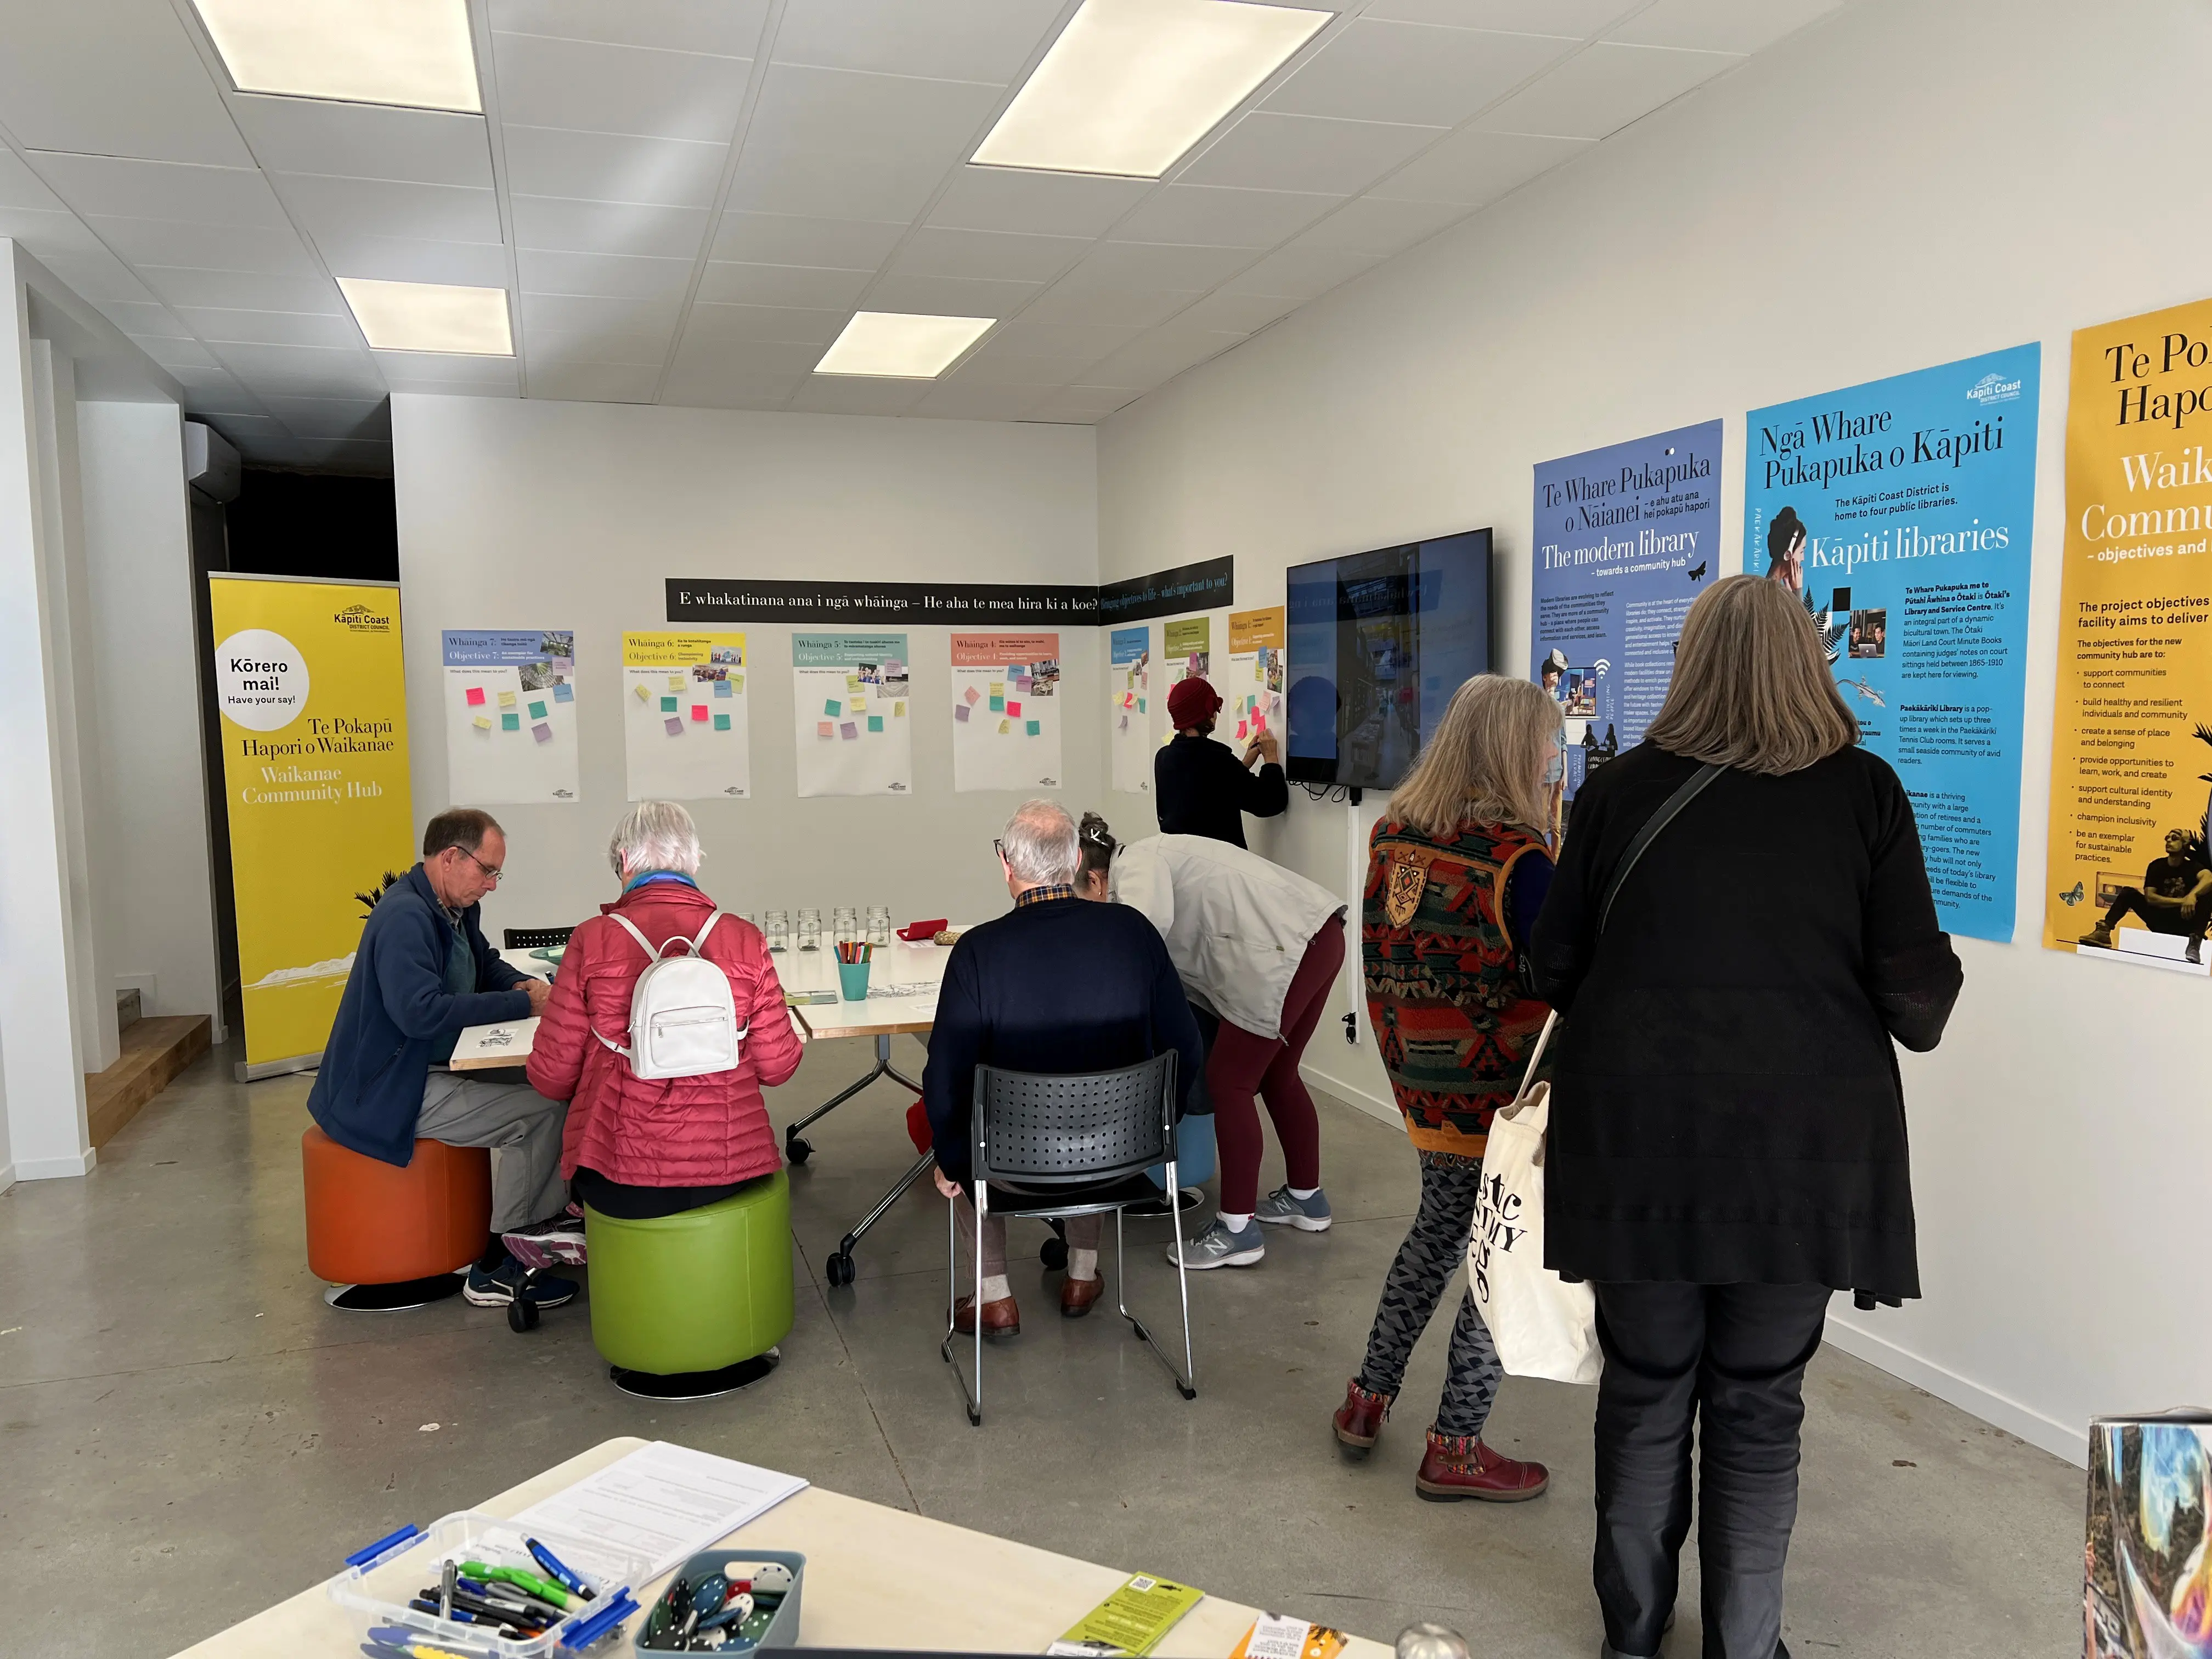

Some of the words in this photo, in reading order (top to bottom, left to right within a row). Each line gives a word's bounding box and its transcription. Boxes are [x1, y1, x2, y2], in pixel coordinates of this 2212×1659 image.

[2105, 343, 2150, 383] Te
[2159, 325, 2212, 373] Po
[1995, 380, 2021, 393] Coast
[1759, 422, 1805, 460] Ngā
[1811, 410, 1892, 445] Whare
[1764, 443, 1883, 490] Pukapuka
[1889, 445, 1905, 467] o
[1911, 416, 2004, 469] Kāpiti
[1543, 484, 1561, 508] Te
[1565, 477, 1616, 504] Whare
[1620, 453, 1711, 493] Pukapuka
[1656, 496, 1669, 506] ahu
[1671, 495, 1683, 504] atu
[1685, 492, 1699, 501] ana
[1835, 498, 1850, 508] The
[1852, 493, 1877, 506] Kāpiti
[1879, 490, 1904, 501] Coast
[1906, 484, 1939, 497] District
[1942, 483, 1949, 493] is
[1565, 517, 1573, 532] o
[1578, 496, 1639, 531] Nāianei
[1644, 509, 1655, 519] hei
[1657, 504, 1684, 518] pokapū
[1685, 498, 1710, 515] hapori
[1835, 509, 1857, 521] home
[1859, 507, 1868, 517] to
[1870, 505, 1887, 516] four
[1889, 501, 1916, 516] public
[1918, 496, 1958, 510] libraries.
[1542, 545, 1571, 569] The
[1575, 537, 1634, 565] modern
[1639, 529, 1700, 558] library
[1810, 530, 1888, 575] Kāpiti
[1895, 518, 2010, 560] libraries
[2098, 541, 2172, 563] objectives
[2177, 539, 2206, 555] and
[1596, 566, 1623, 577] towards
[1630, 559, 1670, 573] community
[1672, 557, 1686, 567] hub
[1148, 588, 1156, 600] life
[1177, 578, 1204, 598] important
[1206, 578, 1212, 589] to
[1214, 572, 1227, 592] you?
[680, 591, 690, 604] E
[696, 592, 784, 606] whakatinana
[789, 597, 812, 607] ana
[817, 594, 822, 607] i
[826, 595, 849, 610] ngā
[854, 595, 907, 611] whāinga
[924, 596, 943, 608] He
[946, 596, 968, 608] aha
[974, 599, 985, 608] te
[989, 601, 1014, 610] mea
[1018, 597, 1042, 610] hira
[1046, 598, 1057, 610] ki
[1062, 601, 1068, 610] a
[1072, 599, 1097, 610] koe?
[2079, 602, 2098, 612] The
[2101, 600, 2143, 613] project
[2146, 596, 2209, 610] objectives
[364, 615, 390, 624] Coast
[2079, 617, 2116, 629] facility
[2119, 615, 2147, 625] aims
[2151, 615, 2163, 624] to
[2167, 612, 2209, 623] deliver
[629, 639, 665, 648] Whāinga
[2093, 639, 2134, 648] objectives
[449, 651, 490, 661] Objective
[629, 652, 665, 662] Objective
[799, 653, 834, 663] Objective
[957, 653, 990, 662] Objective
[2077, 652, 2120, 660] community
[231, 658, 287, 673] Kōrero
[1902, 661, 1925, 669] sittings
[2084, 670, 2113, 678] support
[2115, 668, 2166, 676] communities
[243, 676, 279, 690] mai!
[228, 696, 252, 704] Have
[255, 696, 275, 705] your
[278, 696, 296, 705] say!
[1939, 705, 1963, 714] Library
[308, 718, 329, 735] Te
[333, 717, 392, 738] Pokapū
[241, 737, 301, 760] Hapori
[306, 743, 315, 754] o
[316, 737, 393, 753] Waikanae
[261, 766, 341, 783] Waikanae
[242, 783, 345, 804] Community
[347, 781, 382, 798] Hub
[2077, 813, 2115, 823] champion
[2117, 815, 2157, 827] inclusivity
